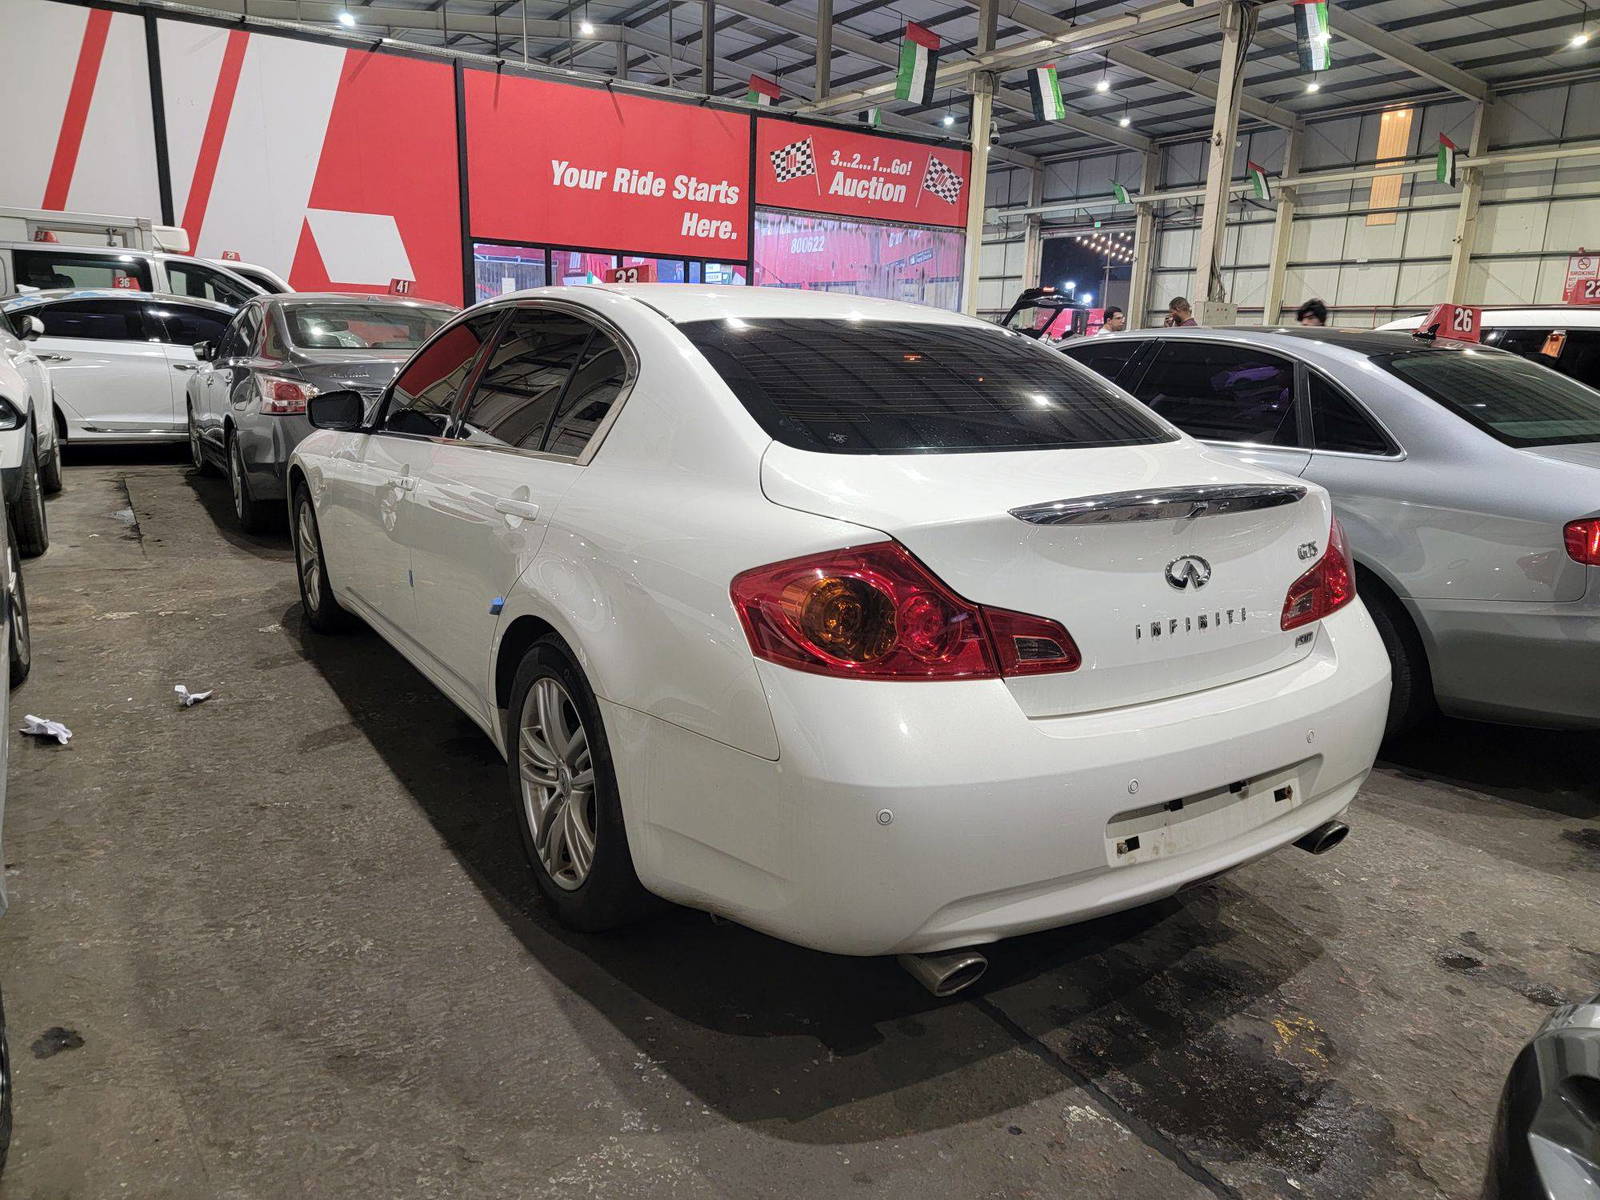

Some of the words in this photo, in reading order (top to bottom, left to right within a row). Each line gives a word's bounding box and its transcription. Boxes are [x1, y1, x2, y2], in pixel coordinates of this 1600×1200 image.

[830, 150, 913, 176] 3...2...1...Go!
[551, 159, 607, 190] Your
[612, 167, 666, 197] Ride
[672, 174, 740, 205] Starts
[828, 171, 907, 203] Auction
[680, 211, 738, 240] Here.
[790, 235, 825, 254] 800622
[119, 278, 130, 288] 36
[396, 280, 409, 293] 41
[1454, 307, 1473, 332] 26
[1135, 607, 1247, 640] INFINITI
